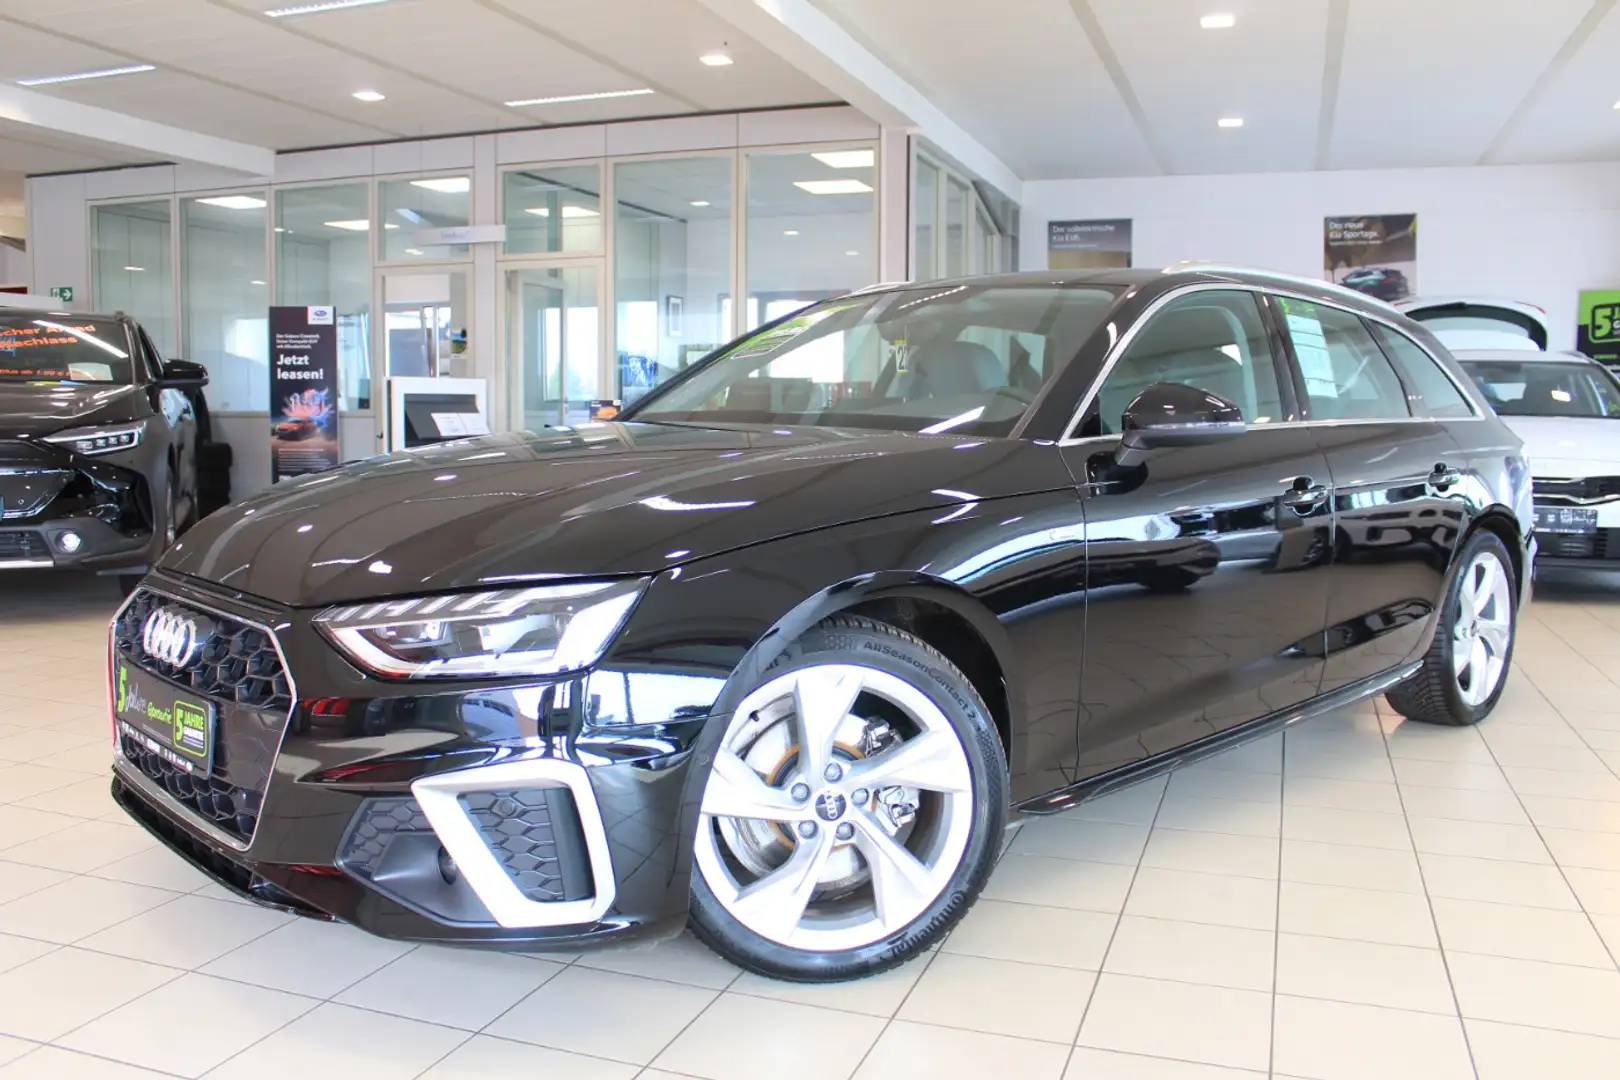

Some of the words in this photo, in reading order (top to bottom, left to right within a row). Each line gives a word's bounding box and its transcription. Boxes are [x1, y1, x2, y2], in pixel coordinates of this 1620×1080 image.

[1594, 307, 1612, 338] 5
[276, 354, 310, 366] Jetzt
[276, 367, 324, 380] leasen!
[117, 665, 127, 713] 5
[863, 641, 969, 711] AllSeasonContact
[175, 707, 184, 741] 5
[183, 709, 204, 731] JAHRE
[886, 890, 965, 957] Continental
